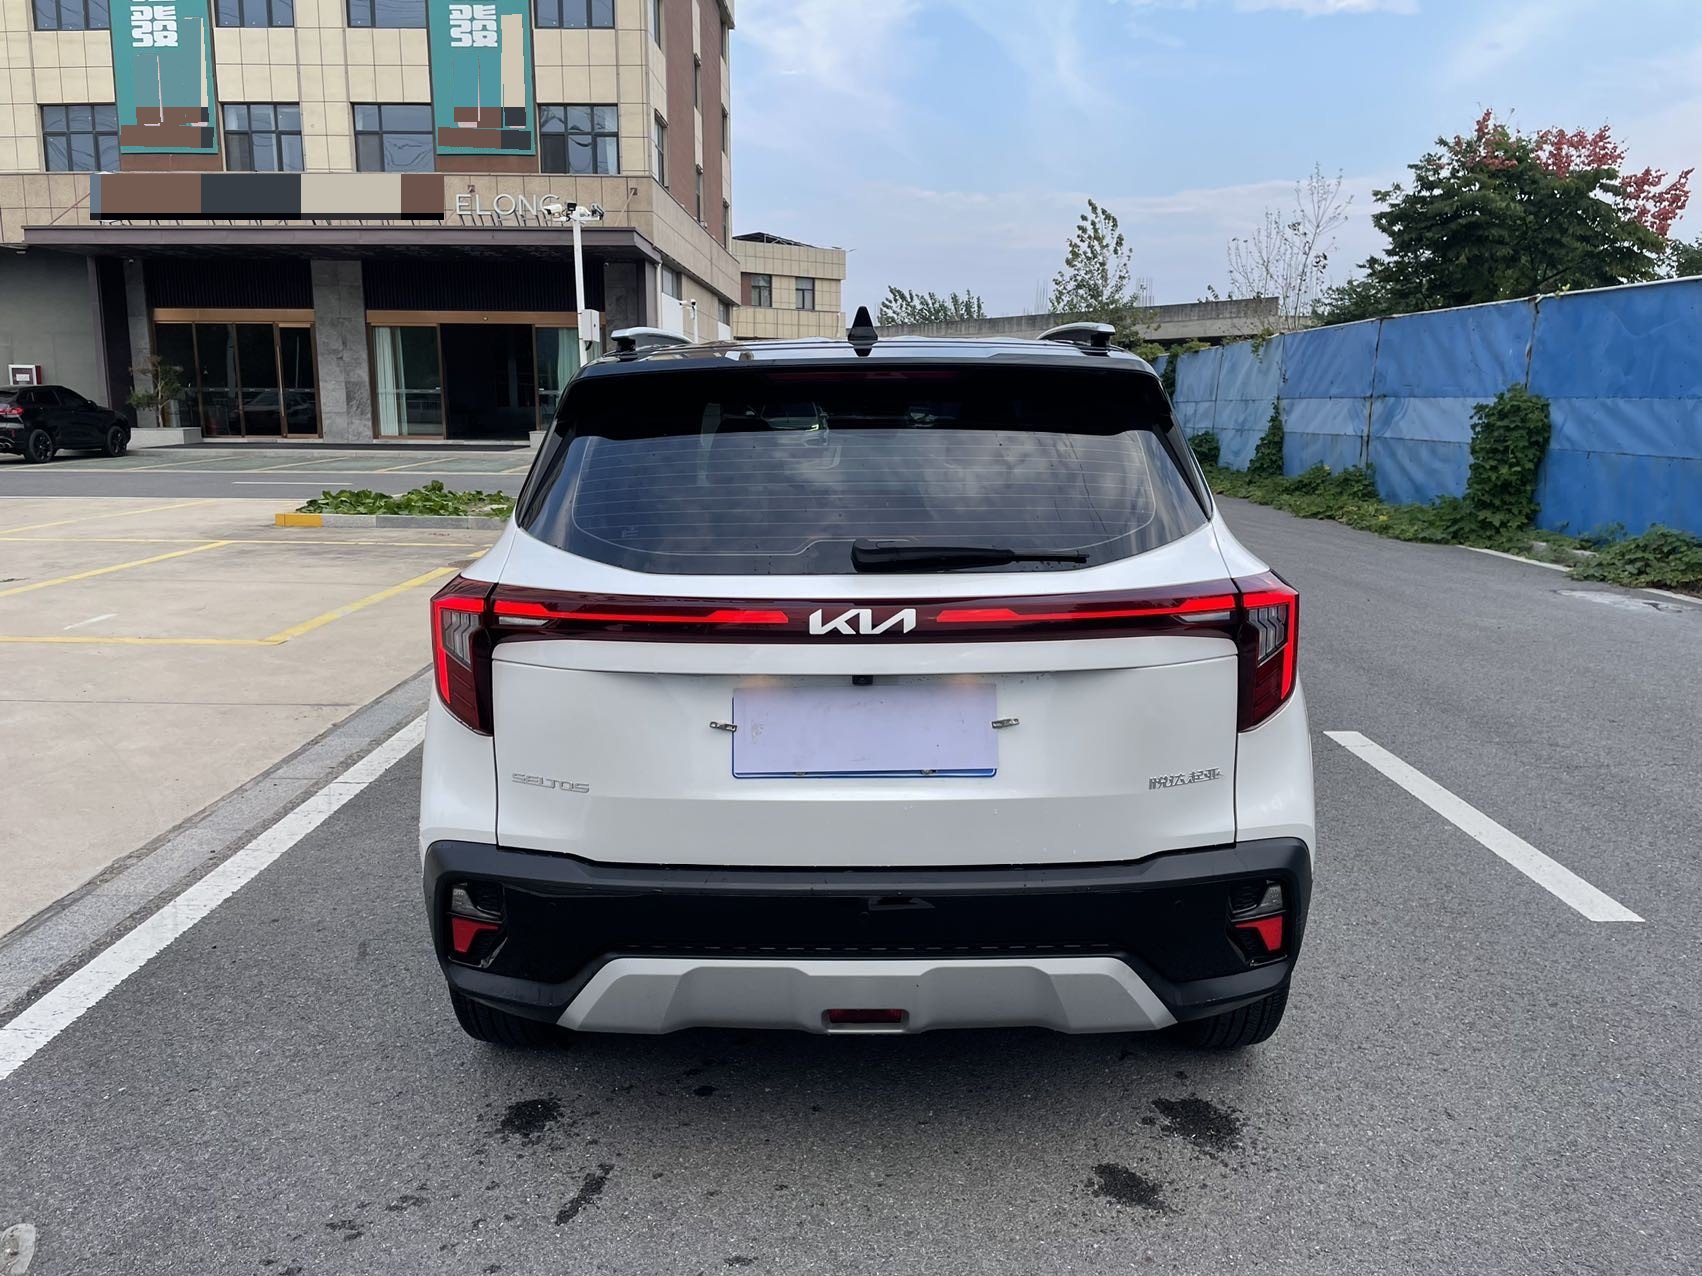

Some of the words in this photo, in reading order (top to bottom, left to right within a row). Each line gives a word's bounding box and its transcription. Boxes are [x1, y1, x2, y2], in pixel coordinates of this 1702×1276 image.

[809, 608, 917, 635] KIA
[512, 773, 590, 794] SELTOS
[1149, 767, 1223, 790] 悦达起亚
